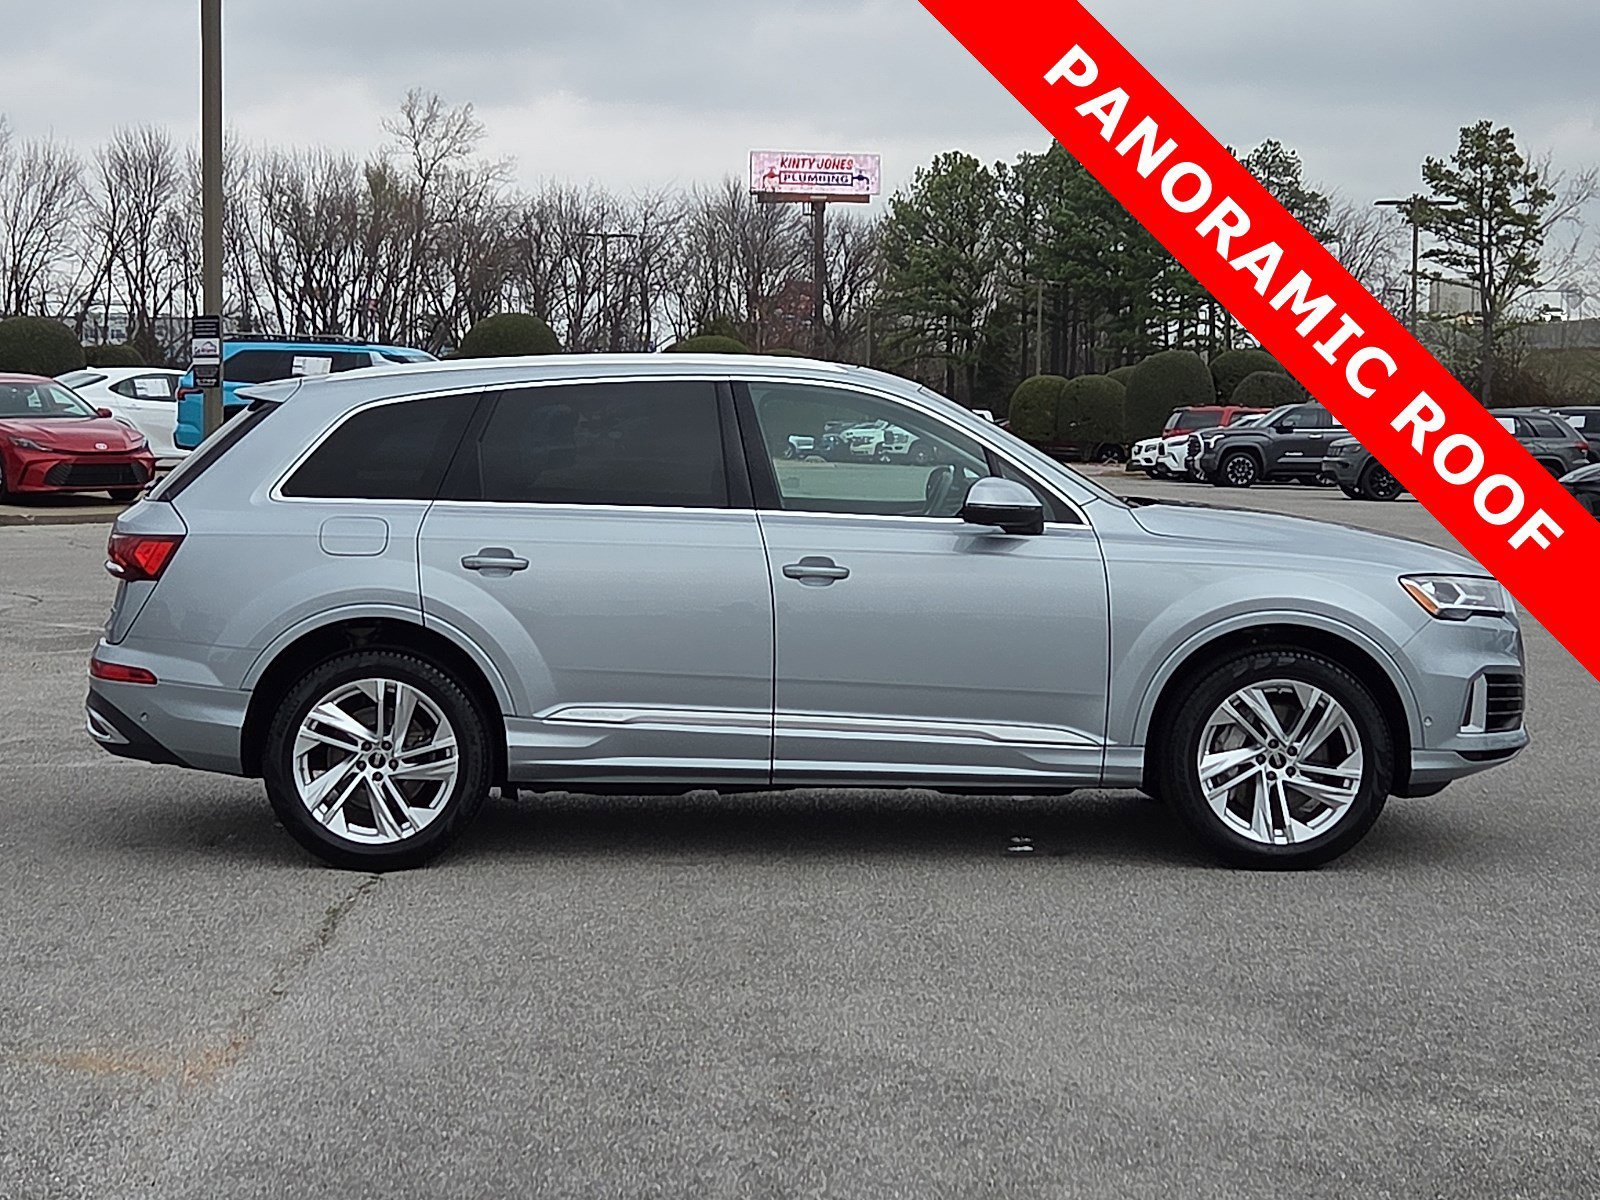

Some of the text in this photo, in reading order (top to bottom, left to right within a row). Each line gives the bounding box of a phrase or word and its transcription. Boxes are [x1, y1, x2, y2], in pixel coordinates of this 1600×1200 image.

[780, 156, 854, 170] KINTY JONES
[783, 174, 849, 184] PLUMBING
